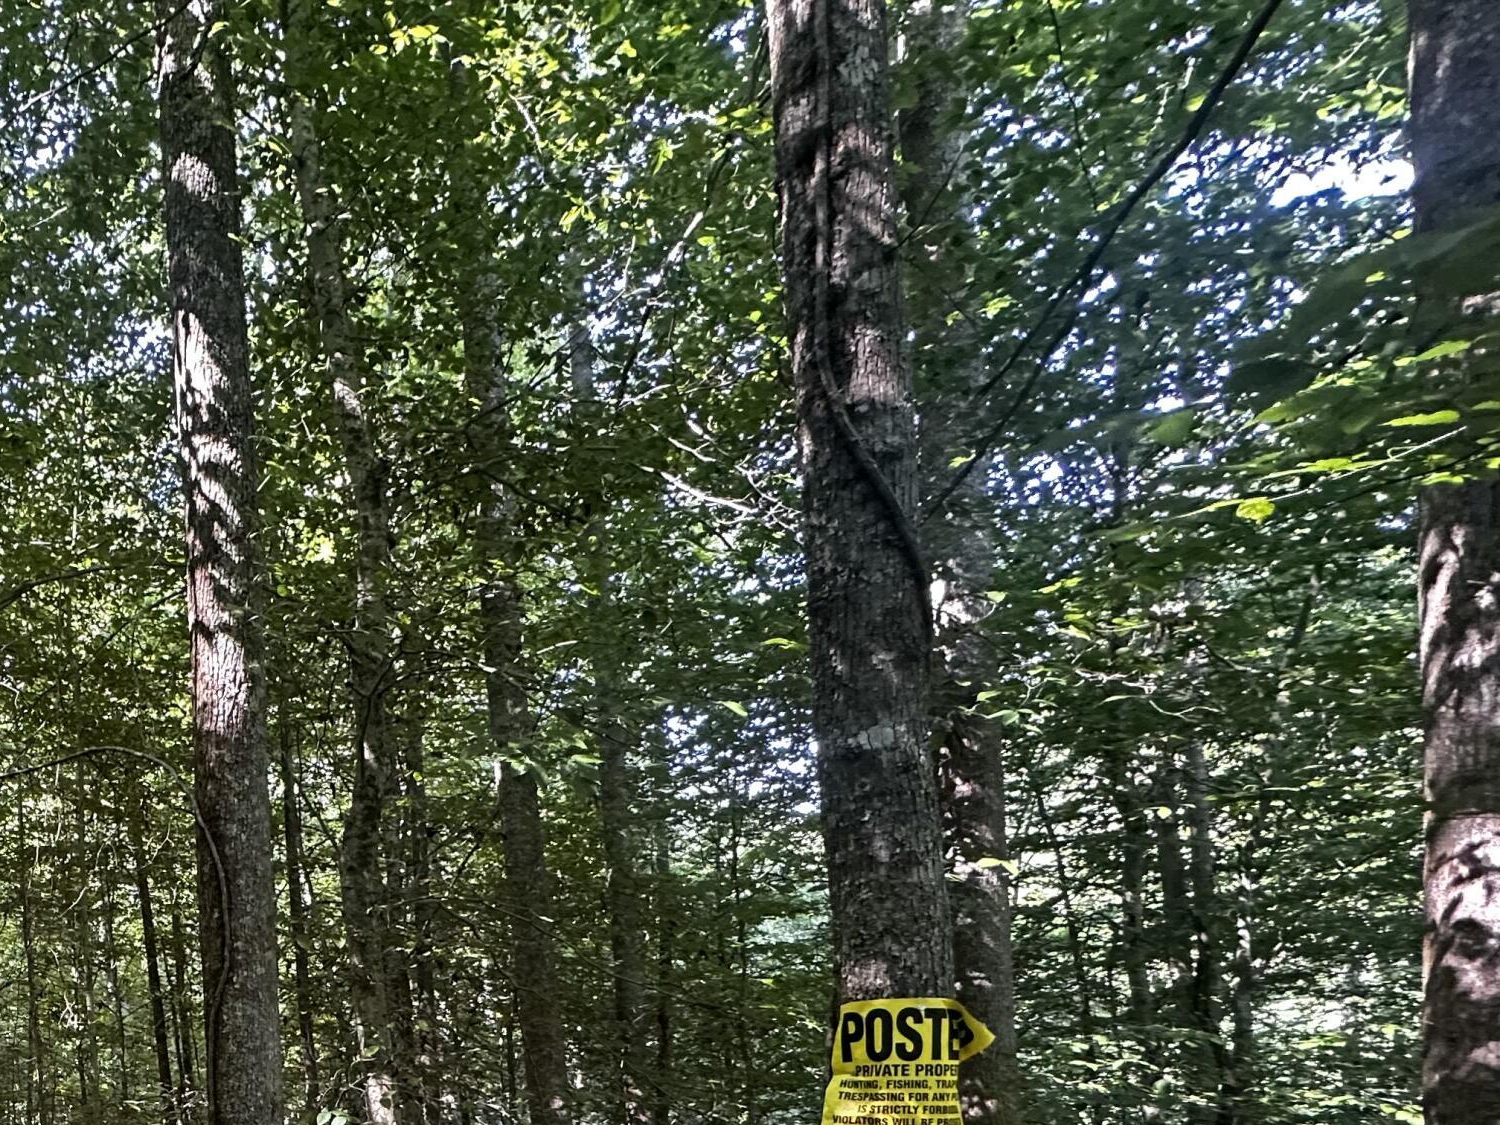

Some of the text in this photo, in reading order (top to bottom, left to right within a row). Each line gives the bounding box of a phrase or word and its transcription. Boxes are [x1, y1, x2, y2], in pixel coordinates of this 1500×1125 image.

[855, 1064, 958, 1077] PRIVATE PROPE
[839, 1080, 882, 1090] HUNTING,
[886, 1080, 932, 1090] FISHING,
[838, 1091, 905, 1101] TRESPASSING
[909, 1092, 929, 1101] FOR
[932, 1092, 950, 1101] ANY
[857, 1105, 867, 1113] IS
[869, 1105, 919, 1114] STRICTLY
[833, 1114, 888, 1125] VIOLATORS
